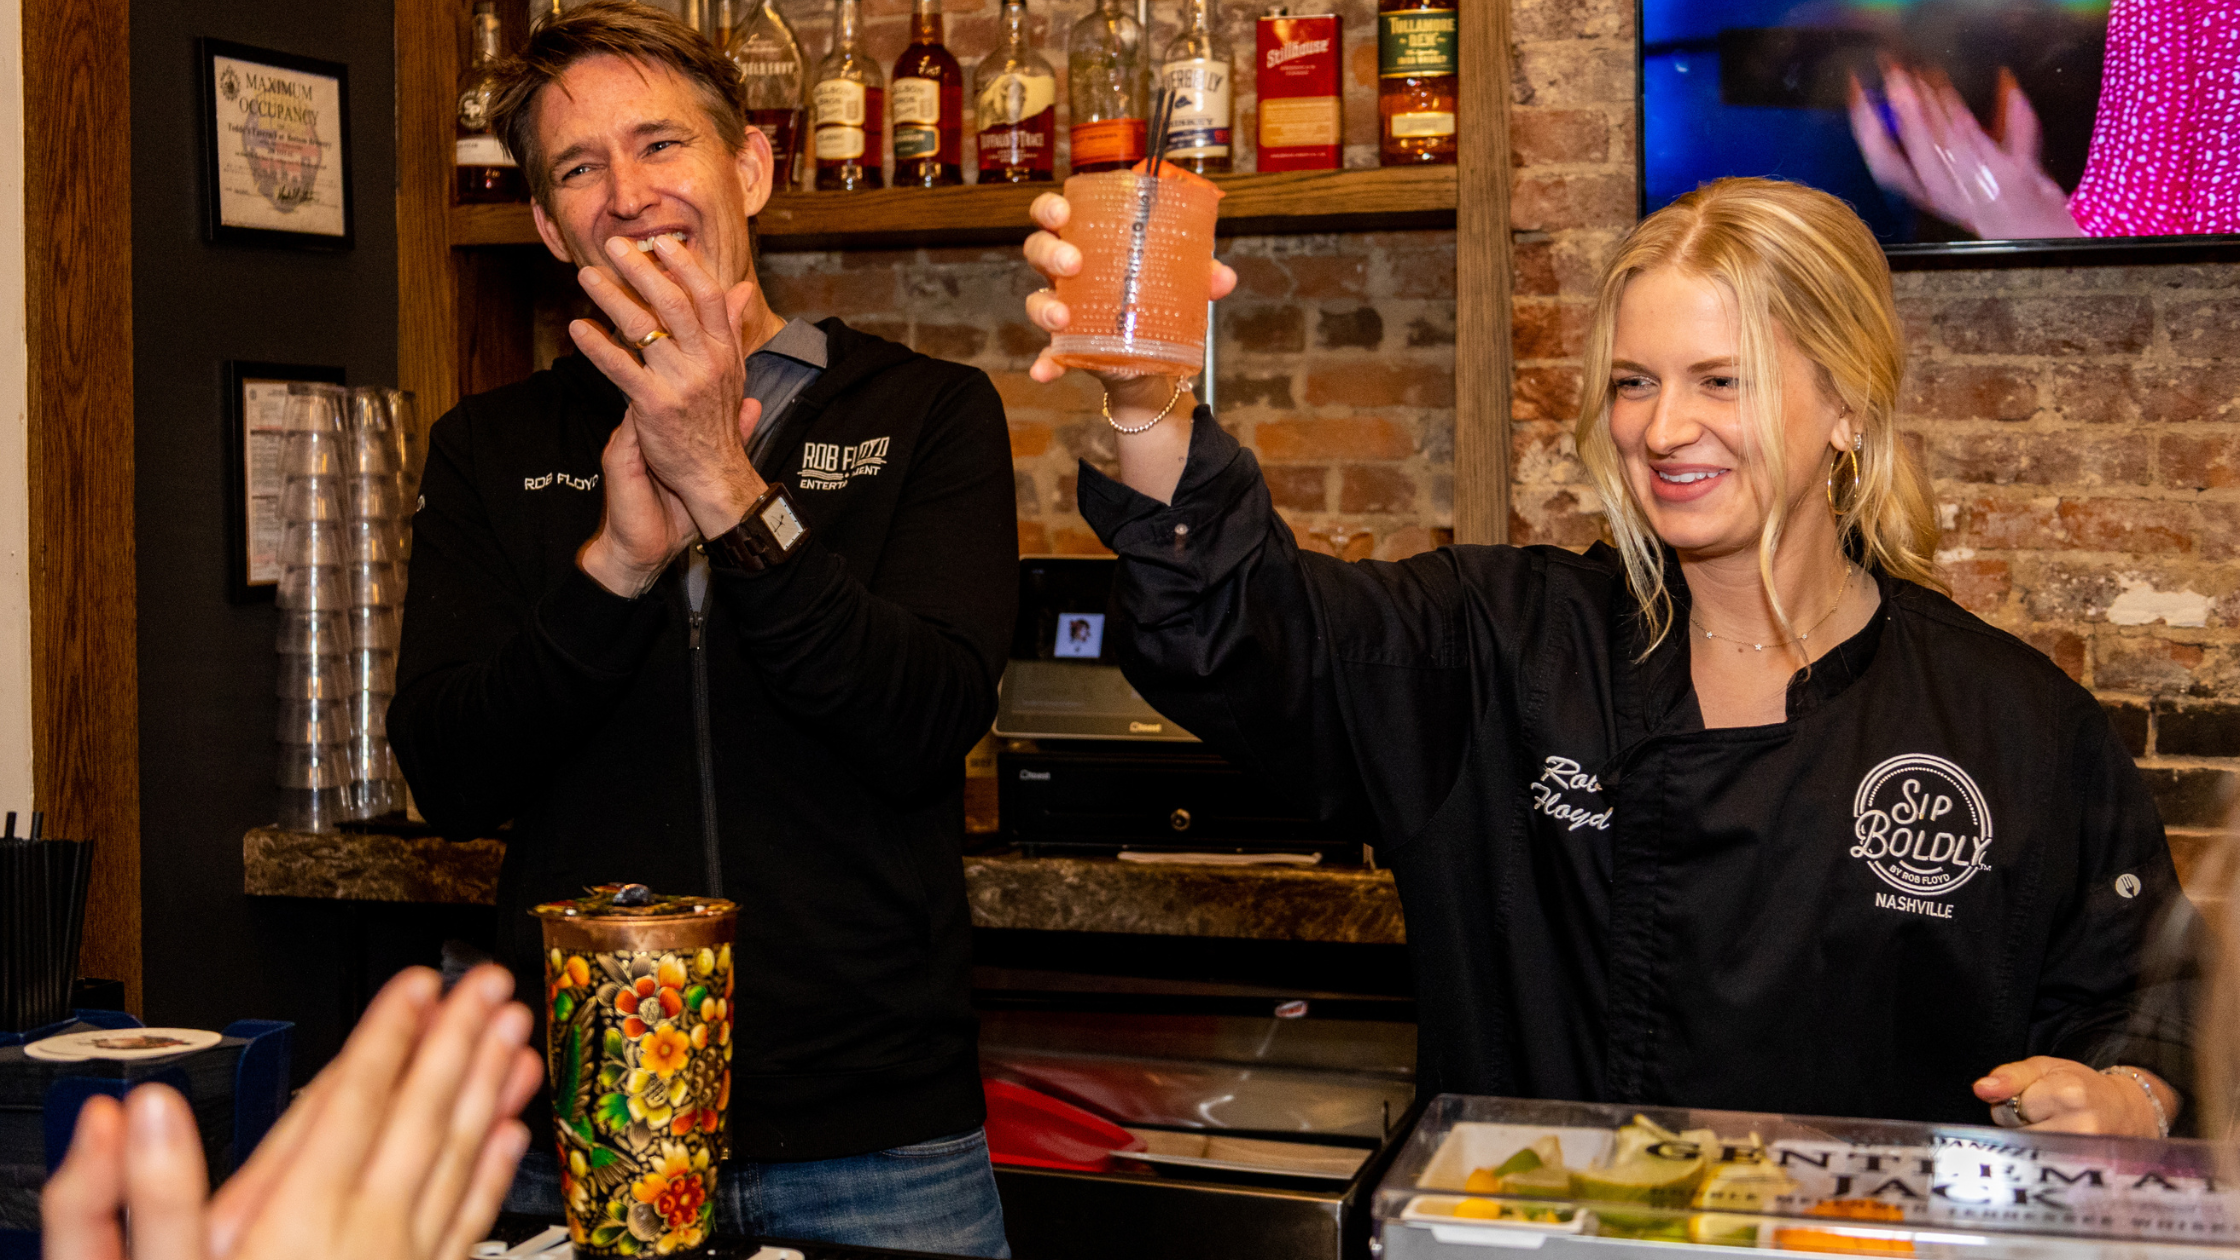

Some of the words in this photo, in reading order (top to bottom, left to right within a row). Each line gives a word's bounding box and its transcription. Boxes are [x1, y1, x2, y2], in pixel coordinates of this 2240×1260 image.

[1388, 17, 1456, 34] TULLAMORE
[1266, 38, 1331, 69] Stillhouse
[246, 73, 313, 101] MAXIMUM
[239, 98, 319, 126] OCCUPANCY
[802, 442, 840, 472] ROB
[842, 436, 890, 471] FLOYD
[524, 472, 553, 490] ROB
[1530, 782, 1614, 831] Floyd
[1850, 809, 1993, 867] BOLDLY
[1889, 864, 1902, 877] BY
[1902, 871, 1921, 884] ROB
[1921, 872, 1951, 885] FLOYD
[1875, 892, 1955, 918] NASHVILLE
[1828, 1173, 2077, 1213] JACK
